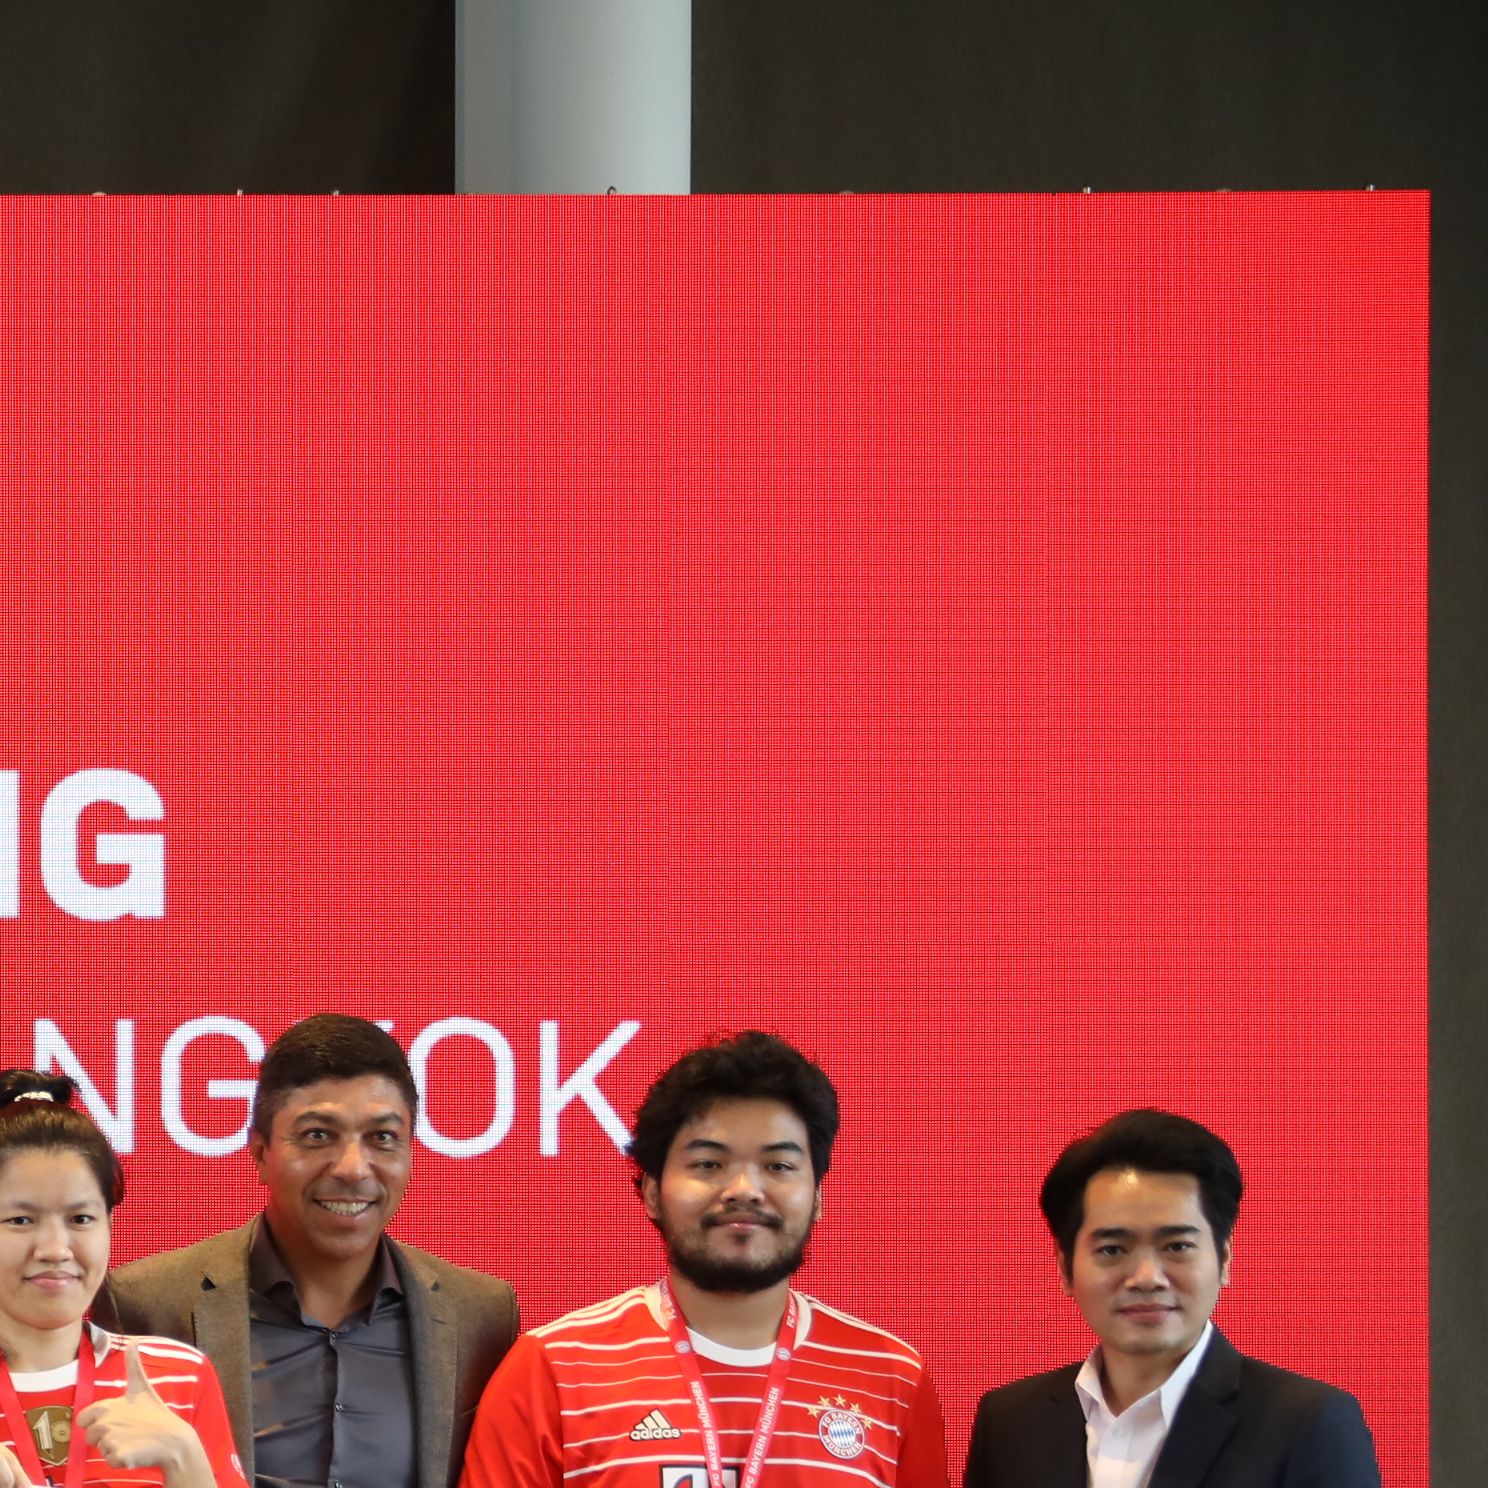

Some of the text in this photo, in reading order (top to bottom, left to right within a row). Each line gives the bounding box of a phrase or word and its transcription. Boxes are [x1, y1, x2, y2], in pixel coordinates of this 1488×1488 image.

[690, 1381, 712, 1428] MÜNCHEN
[630, 1427, 681, 1441] adidas
[705, 1427, 720, 1472] BAYERN
[747, 1433, 766, 1476] BAYERN
[759, 1387, 780, 1433] MÜNCHEN
